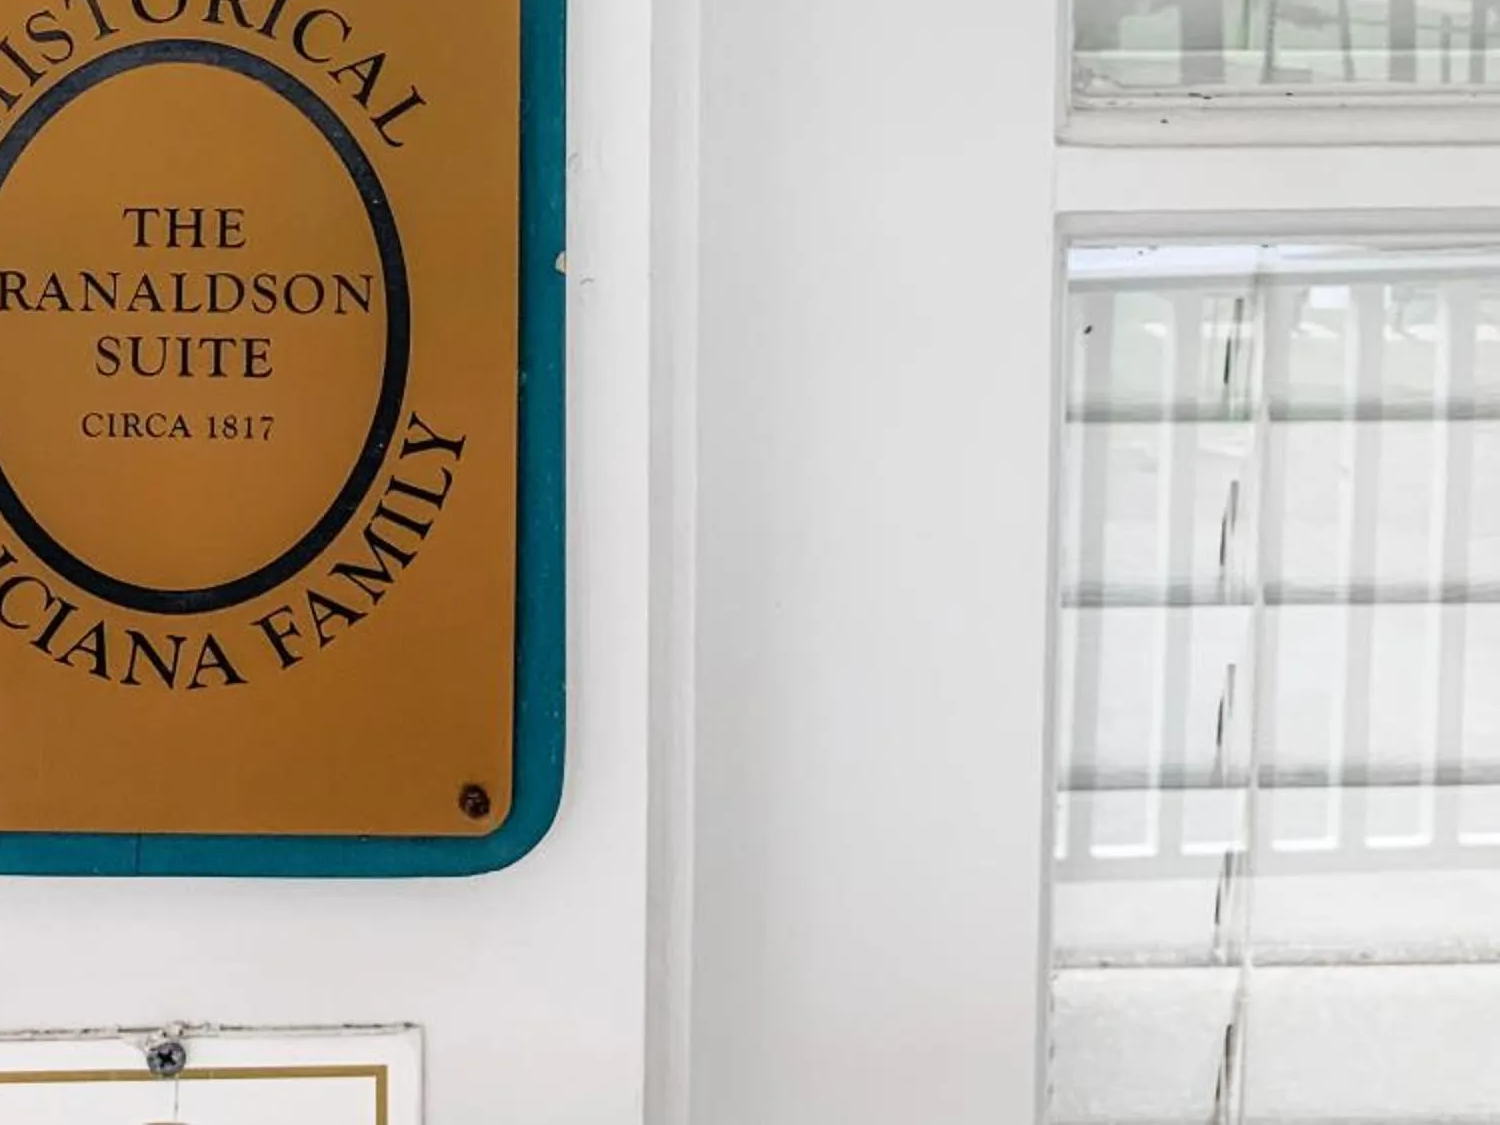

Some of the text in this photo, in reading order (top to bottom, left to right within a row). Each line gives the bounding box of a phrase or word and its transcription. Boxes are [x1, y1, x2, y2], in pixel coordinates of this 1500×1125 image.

[122, 207, 247, 249] THE
[94, 335, 274, 379] SUITE
[80, 412, 276, 441] CIRCA 1817
[249, 410, 467, 671] FAMILY
